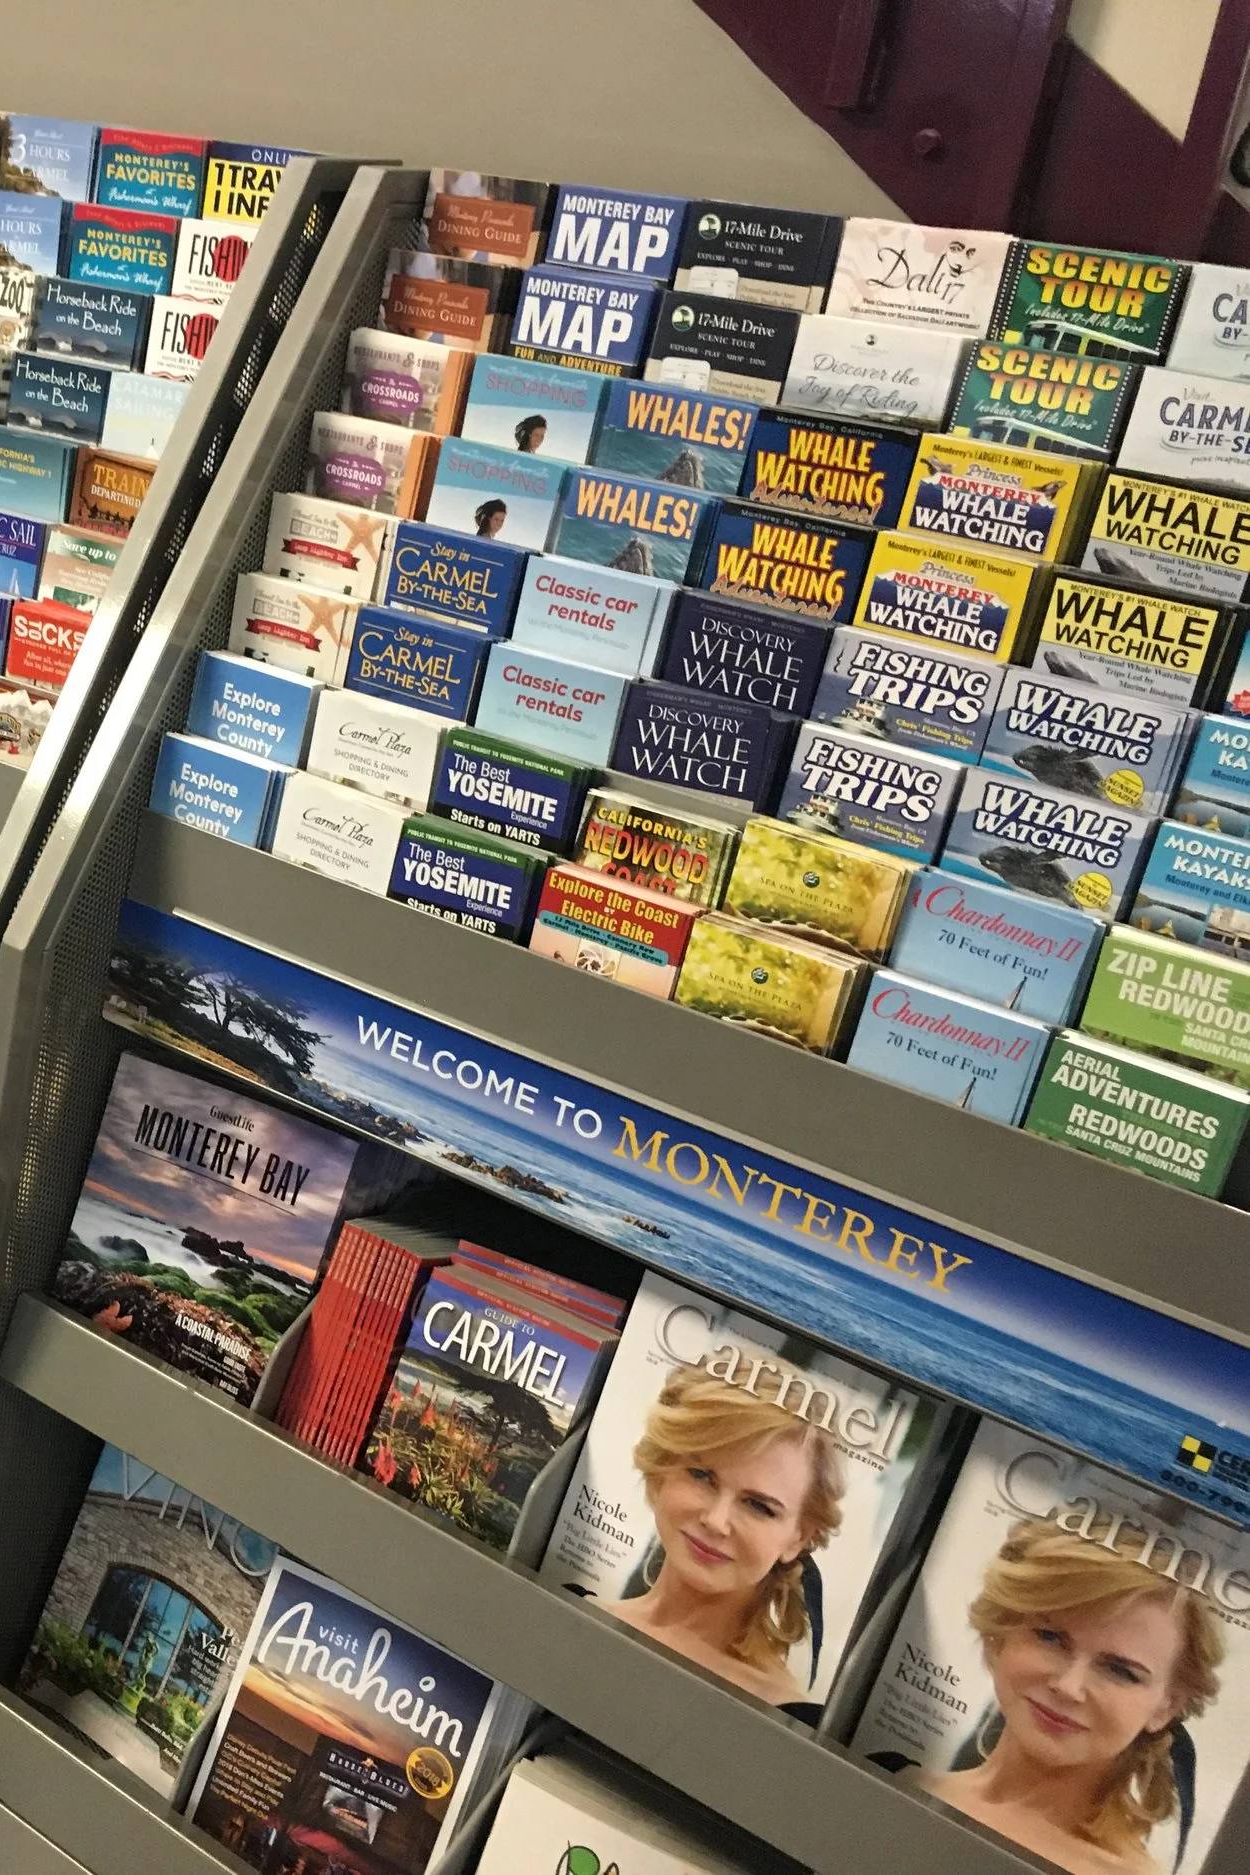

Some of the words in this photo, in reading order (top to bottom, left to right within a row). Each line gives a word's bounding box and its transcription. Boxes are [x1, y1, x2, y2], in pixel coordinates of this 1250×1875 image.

[11, 134, 26, 163] 3
[29, 144, 71, 162] HOURS
[115, 152, 190, 171] MONTEREY'S
[107, 163, 196, 191] FAVORITES
[79, 239, 167, 268] FAVORITES
[436, 219, 481, 238] DINING
[484, 225, 523, 246] GUIDE
[551, 214, 671, 273] MAP
[526, 277, 606, 302] MONTEREY
[608, 288, 639, 308] BAY
[1027, 247, 1172, 293] SCENIC
[47, 283, 108, 315] Horseback
[110, 295, 137, 317] Ride
[393, 300, 437, 320] DINING
[439, 309, 477, 328] GUIDE
[1039, 276, 1148, 320] TOUR
[516, 296, 634, 357] MAP
[743, 321, 776, 339] Drive
[16, 359, 74, 390] Horseback
[76, 370, 102, 394] Ride
[812, 353, 888, 384] Discover
[895, 365, 921, 387] the
[976, 344, 1123, 391] SCENIC
[361, 382, 420, 404] CROSSROADS
[485, 372, 588, 410] SHOPPING
[988, 372, 1099, 416] TOUR
[626, 390, 750, 451] WHALES!
[325, 463, 383, 484] CROSSROADS
[447, 453, 547, 495] SHOPPING
[575, 478, 698, 541] WHALES!
[916, 506, 1044, 553] WATCHING
[941, 488, 1030, 526] WHALE
[1108, 484, 1250, 545] WHALE
[9, 523, 36, 547] SAIL
[751, 523, 839, 570] WHALE
[1105, 520, 1241, 566] WATCHING
[395, 547, 498, 599] CARMEL
[869, 601, 998, 652] WATCHING
[1054, 623, 1190, 669] WATCHING
[358, 631, 461, 684] CARMEL
[689, 630, 803, 684] WHALE
[850, 641, 991, 697] FISHING
[223, 682, 282, 717] Explore
[682, 657, 798, 712] WATCH
[847, 666, 985, 724] TRIPS
[212, 699, 286, 743] Monterey
[1011, 682, 1161, 744] WHALE
[216, 724, 273, 759] County
[636, 719, 751, 765] WHALE
[1006, 709, 1149, 766] WATCHING
[180, 763, 239, 799] Explore
[453, 752, 477, 774] The
[480, 761, 511, 784] Best
[631, 746, 747, 794] WATCH
[805, 739, 941, 796] FISHING
[168, 779, 244, 824] Monterey
[447, 769, 558, 823] YOSEMITE
[801, 764, 936, 823] TRIPS
[982, 783, 1130, 848] WHALE
[174, 804, 230, 838] County
[974, 810, 1119, 868] WATCHING
[409, 842, 433, 864] The
[434, 851, 466, 873] Best
[403, 858, 512, 910] YOSEMITE
[561, 899, 618, 934] Electric
[619, 919, 655, 946] Bike
[938, 928, 957, 946] 70
[958, 937, 992, 962] Feet
[993, 949, 1007, 965] of
[1010, 957, 1050, 981] Fun!
[1106, 947, 1158, 980] ZIP
[1159, 963, 1233, 1003] LINE
[708, 970, 727, 984] SPA
[728, 977, 745, 990] ON
[749, 985, 768, 998] THE
[771, 992, 803, 1011] PLAZA
[885, 1030, 903, 1048] 70
[905, 1039, 939, 1063] Feet
[941, 1052, 956, 1068] of
[958, 1058, 997, 1082] Fun!
[209, 1104, 255, 1133] GuestLife
[1051, 1065, 1220, 1139] ADVENTURES
[134, 1104, 260, 1186] MONTEREY
[258, 1152, 310, 1207] BAY
[356, 1015, 540, 1117] WELCOME
[552, 1095, 604, 1140] TO
[612, 1115, 973, 1296] MONTEREY
[1065, 1124, 1101, 1146] SANTA
[1103, 1138, 1133, 1158] CRUZ
[1134, 1149, 1201, 1183] MOUNTAINS
[1068, 1102, 1210, 1172] REDWOODS
[175, 1314, 183, 1326] A
[181, 1316, 215, 1344] COASTAL
[213, 1330, 252, 1362] PARADISE
[484, 1307, 518, 1330] GUIDE
[521, 1322, 535, 1336] TO
[422, 1301, 567, 1408] CARMEL
[653, 1303, 910, 1463] Carmel
[833, 1442, 886, 1472] magazine
[573, 1502, 635, 1547] Kidman
[579, 1484, 628, 1522] Nicole
[318, 1625, 359, 1655] visit
[257, 1601, 463, 1759] Anaheim
[903, 1641, 962, 1688] Nicole
[895, 1662, 969, 1717] Kidman
[416, 1761, 441, 1785] 2018
